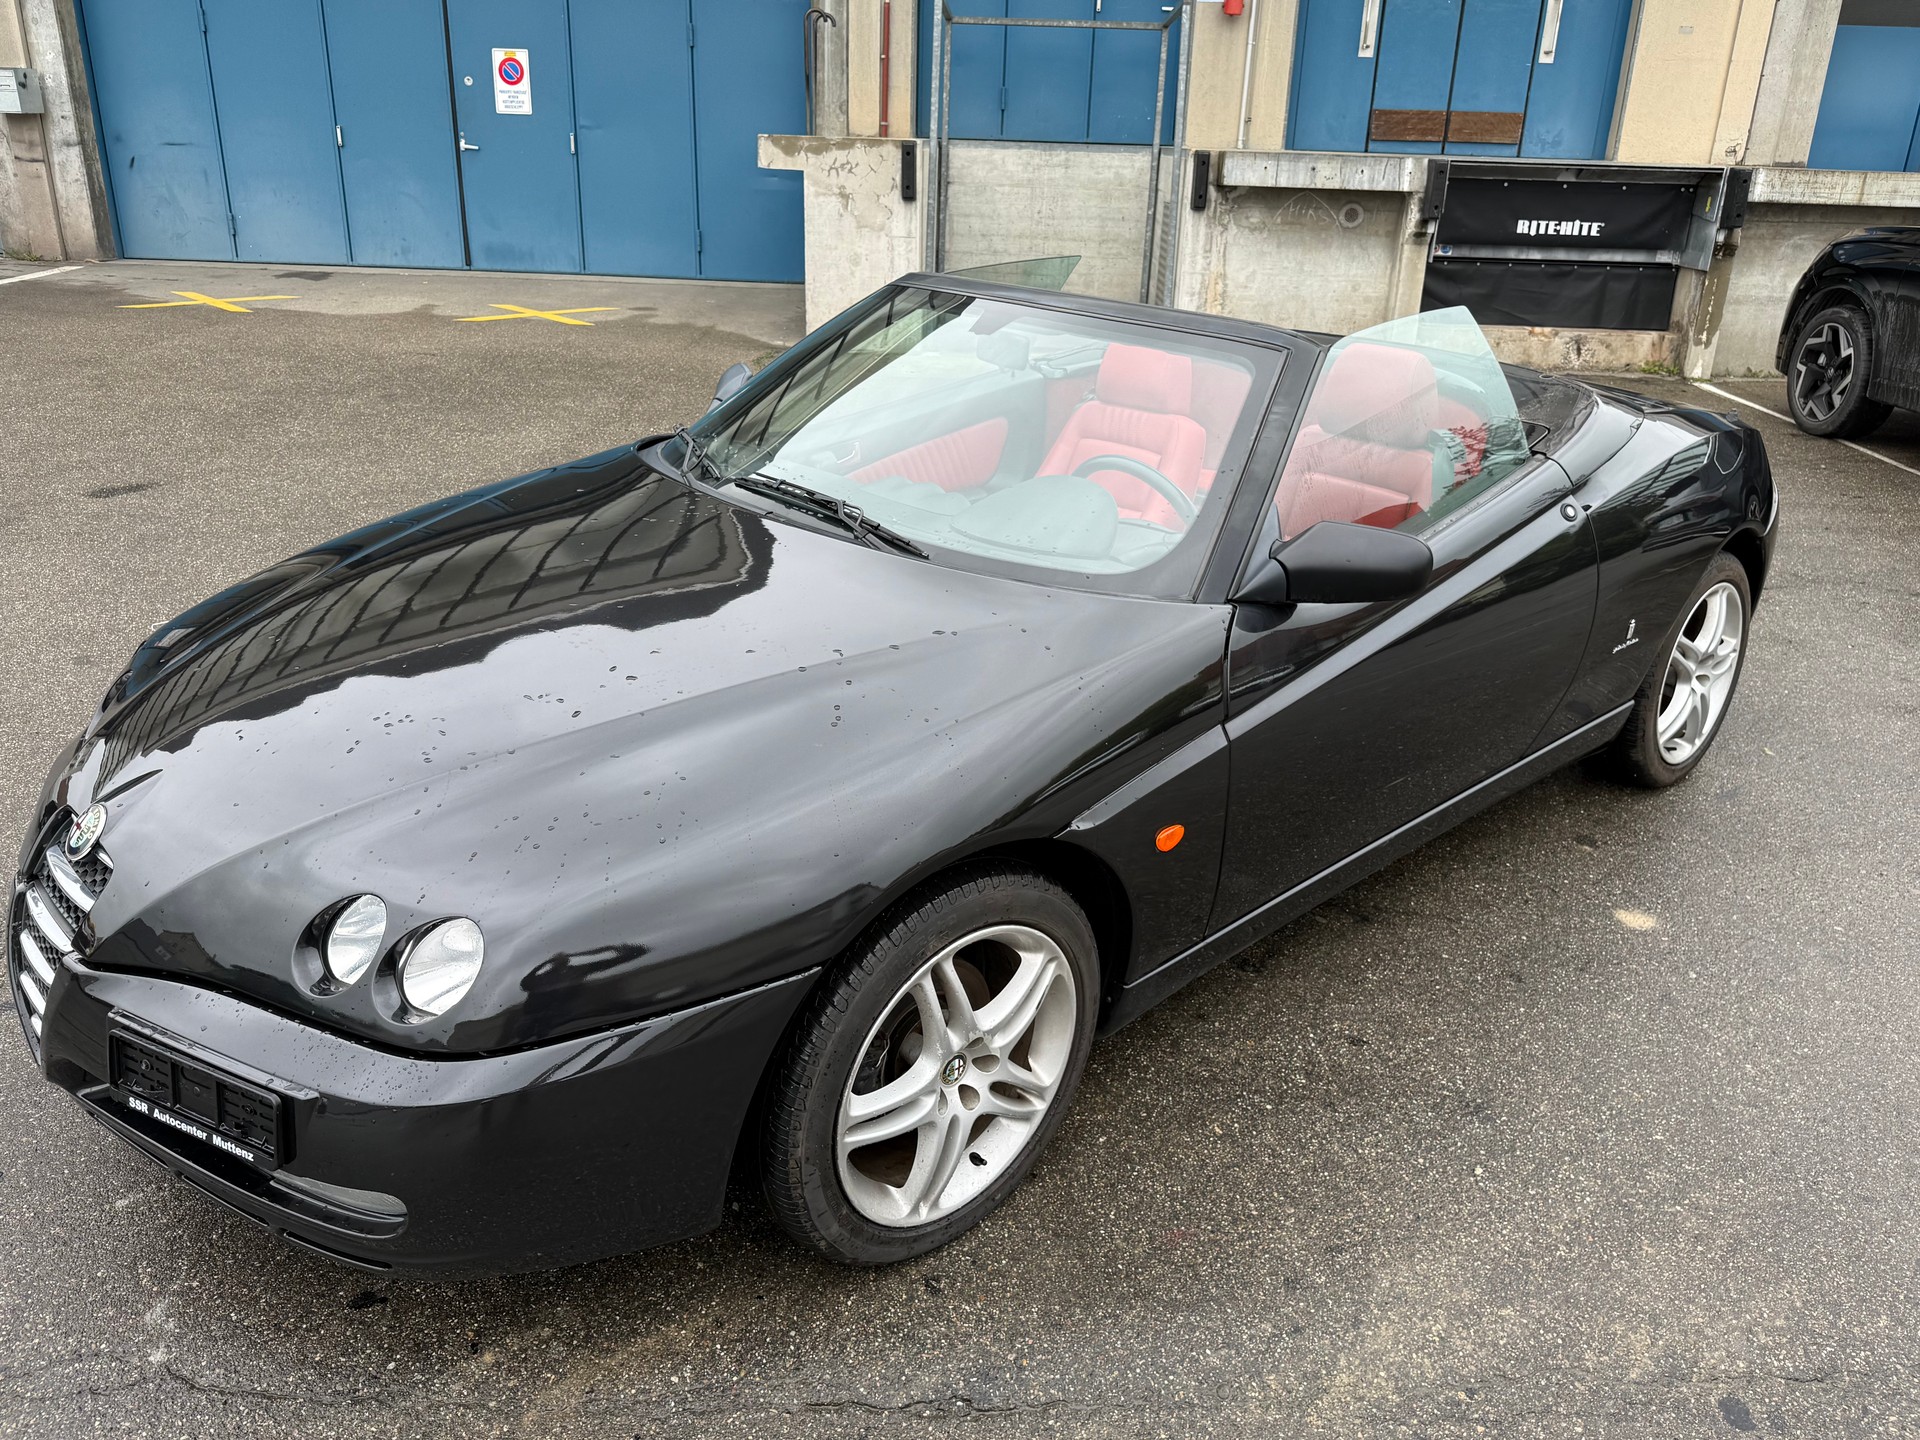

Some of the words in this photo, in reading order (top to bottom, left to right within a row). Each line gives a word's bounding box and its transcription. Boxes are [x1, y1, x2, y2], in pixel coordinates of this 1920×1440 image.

[128, 1096, 149, 1115] SSR
[153, 1108, 208, 1141] Autocenter
[212, 1134, 255, 1162] Muttenz
